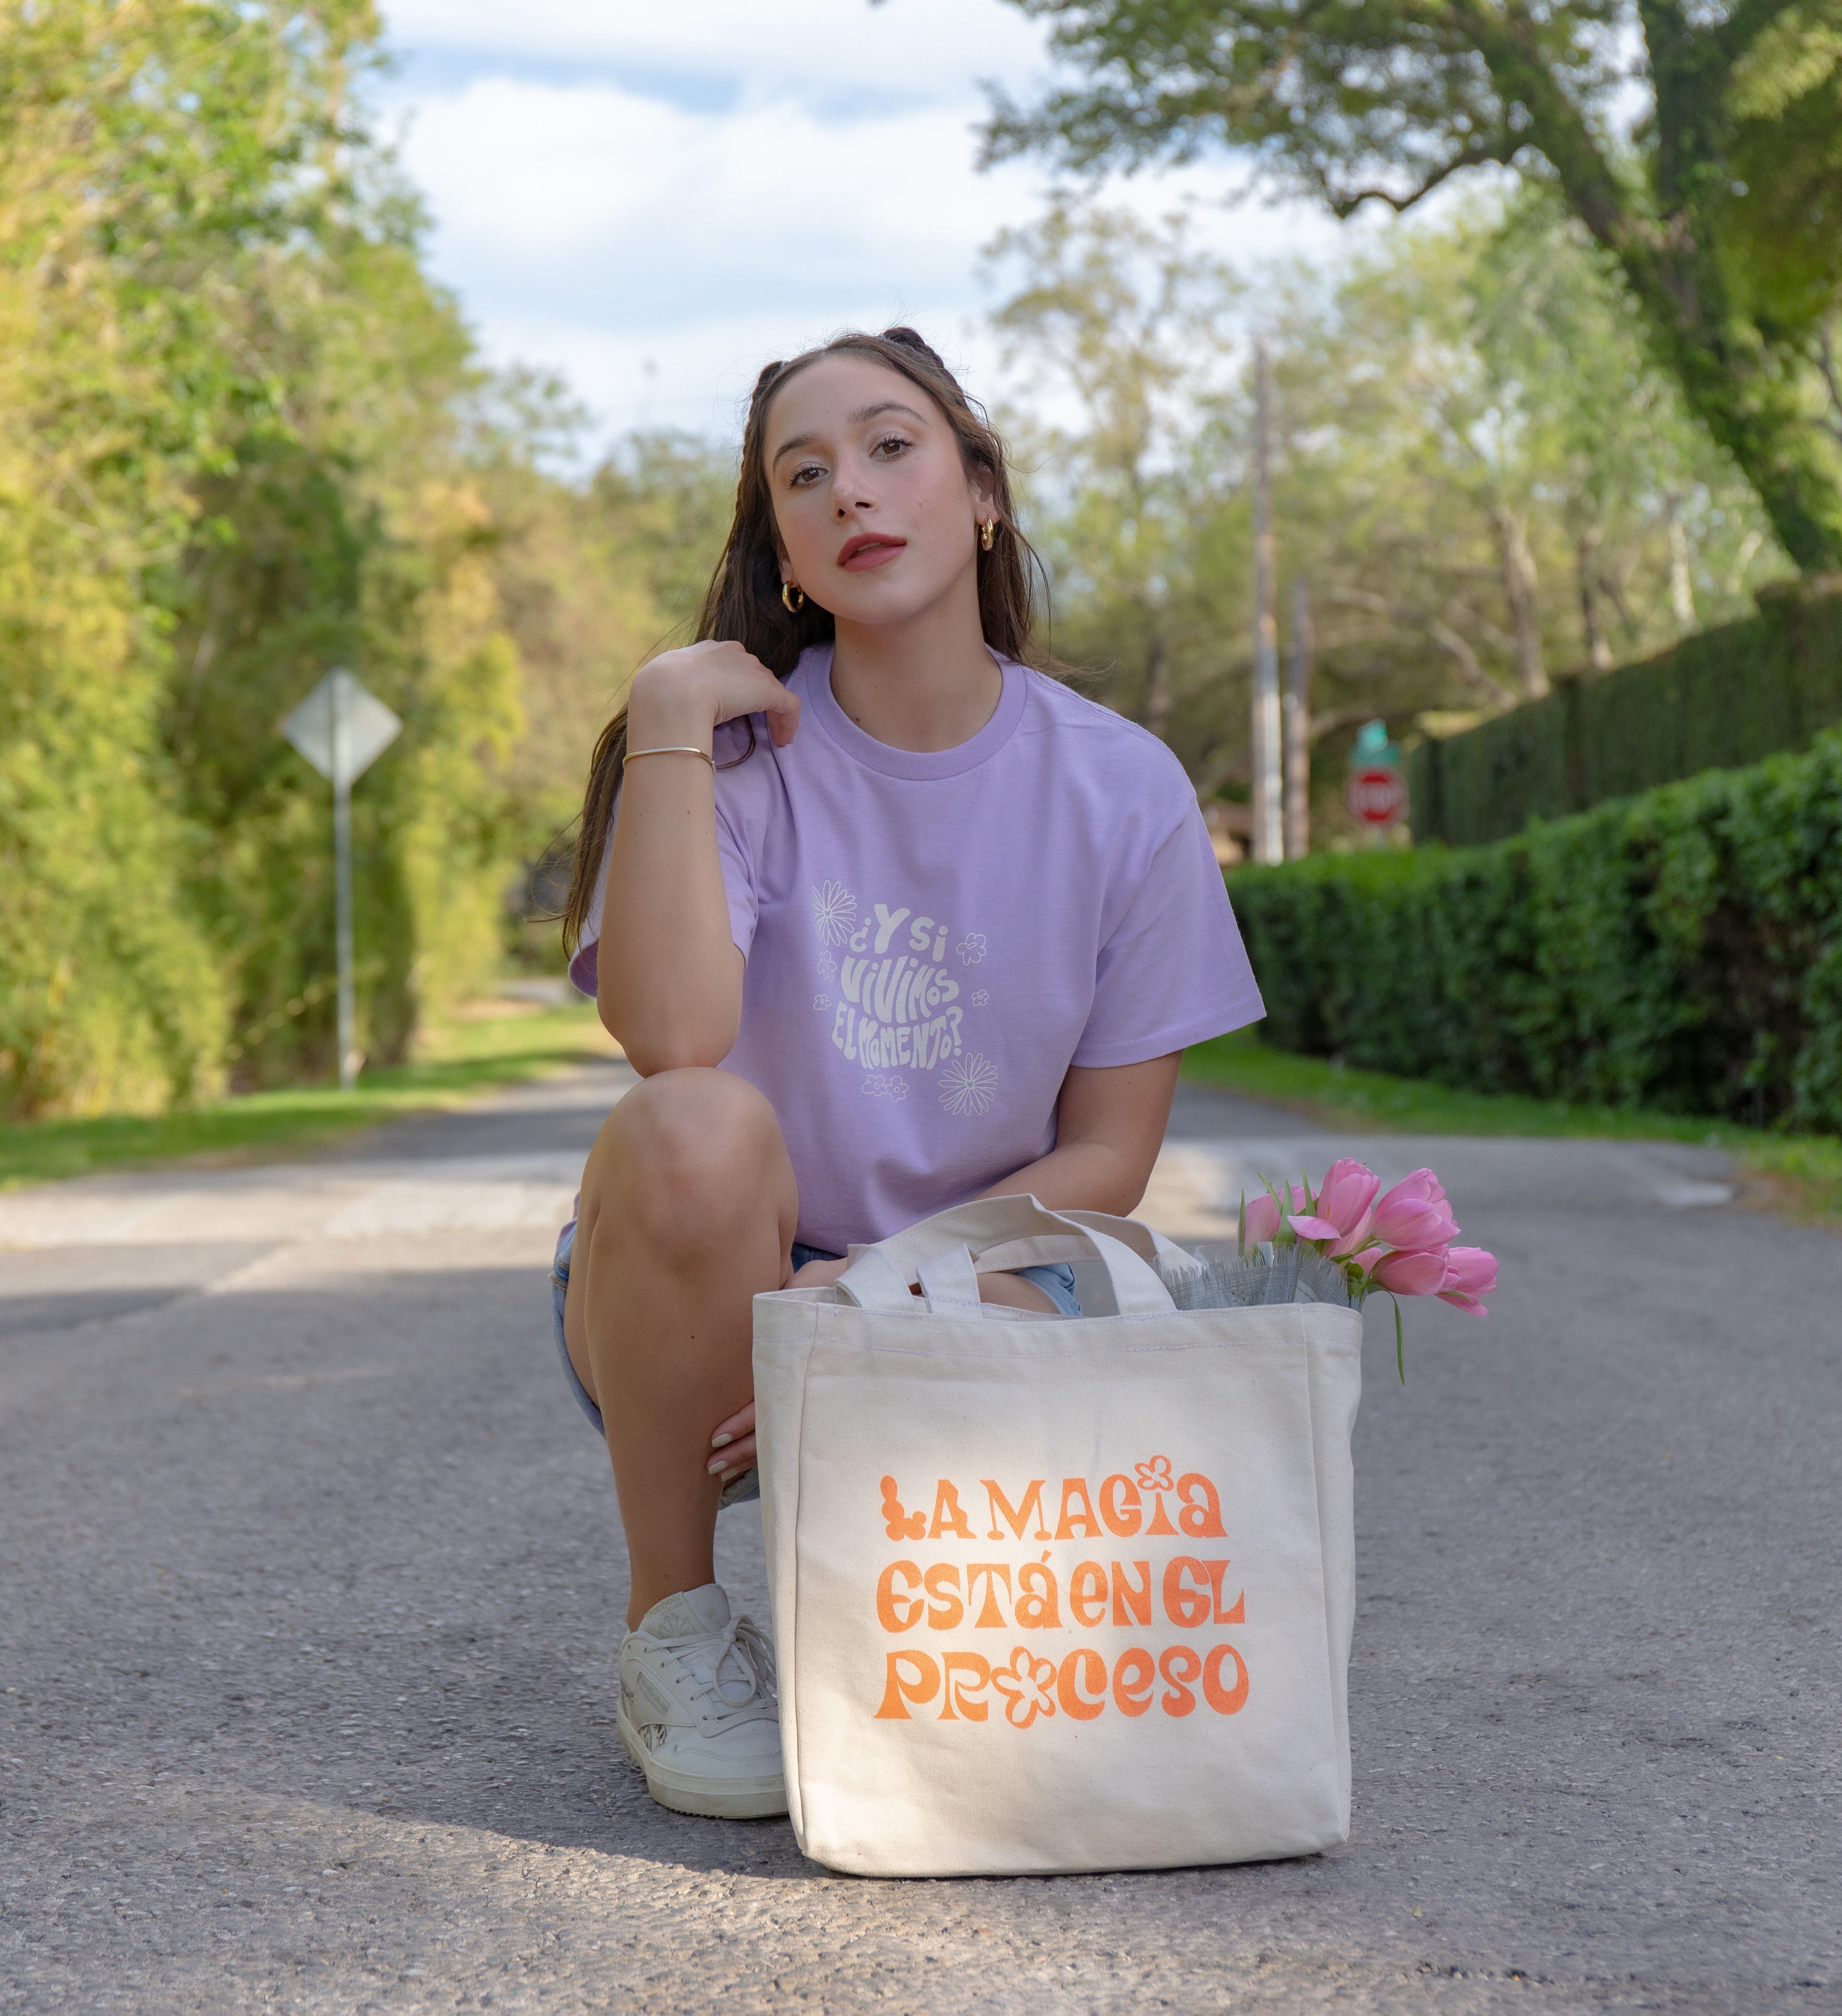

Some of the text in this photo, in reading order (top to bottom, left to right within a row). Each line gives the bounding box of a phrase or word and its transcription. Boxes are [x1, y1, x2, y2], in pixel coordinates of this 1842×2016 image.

[832, 1001, 857, 1061] EL
[880, 1475, 977, 1541] LA
[1162, 1556, 1246, 1628] EL
